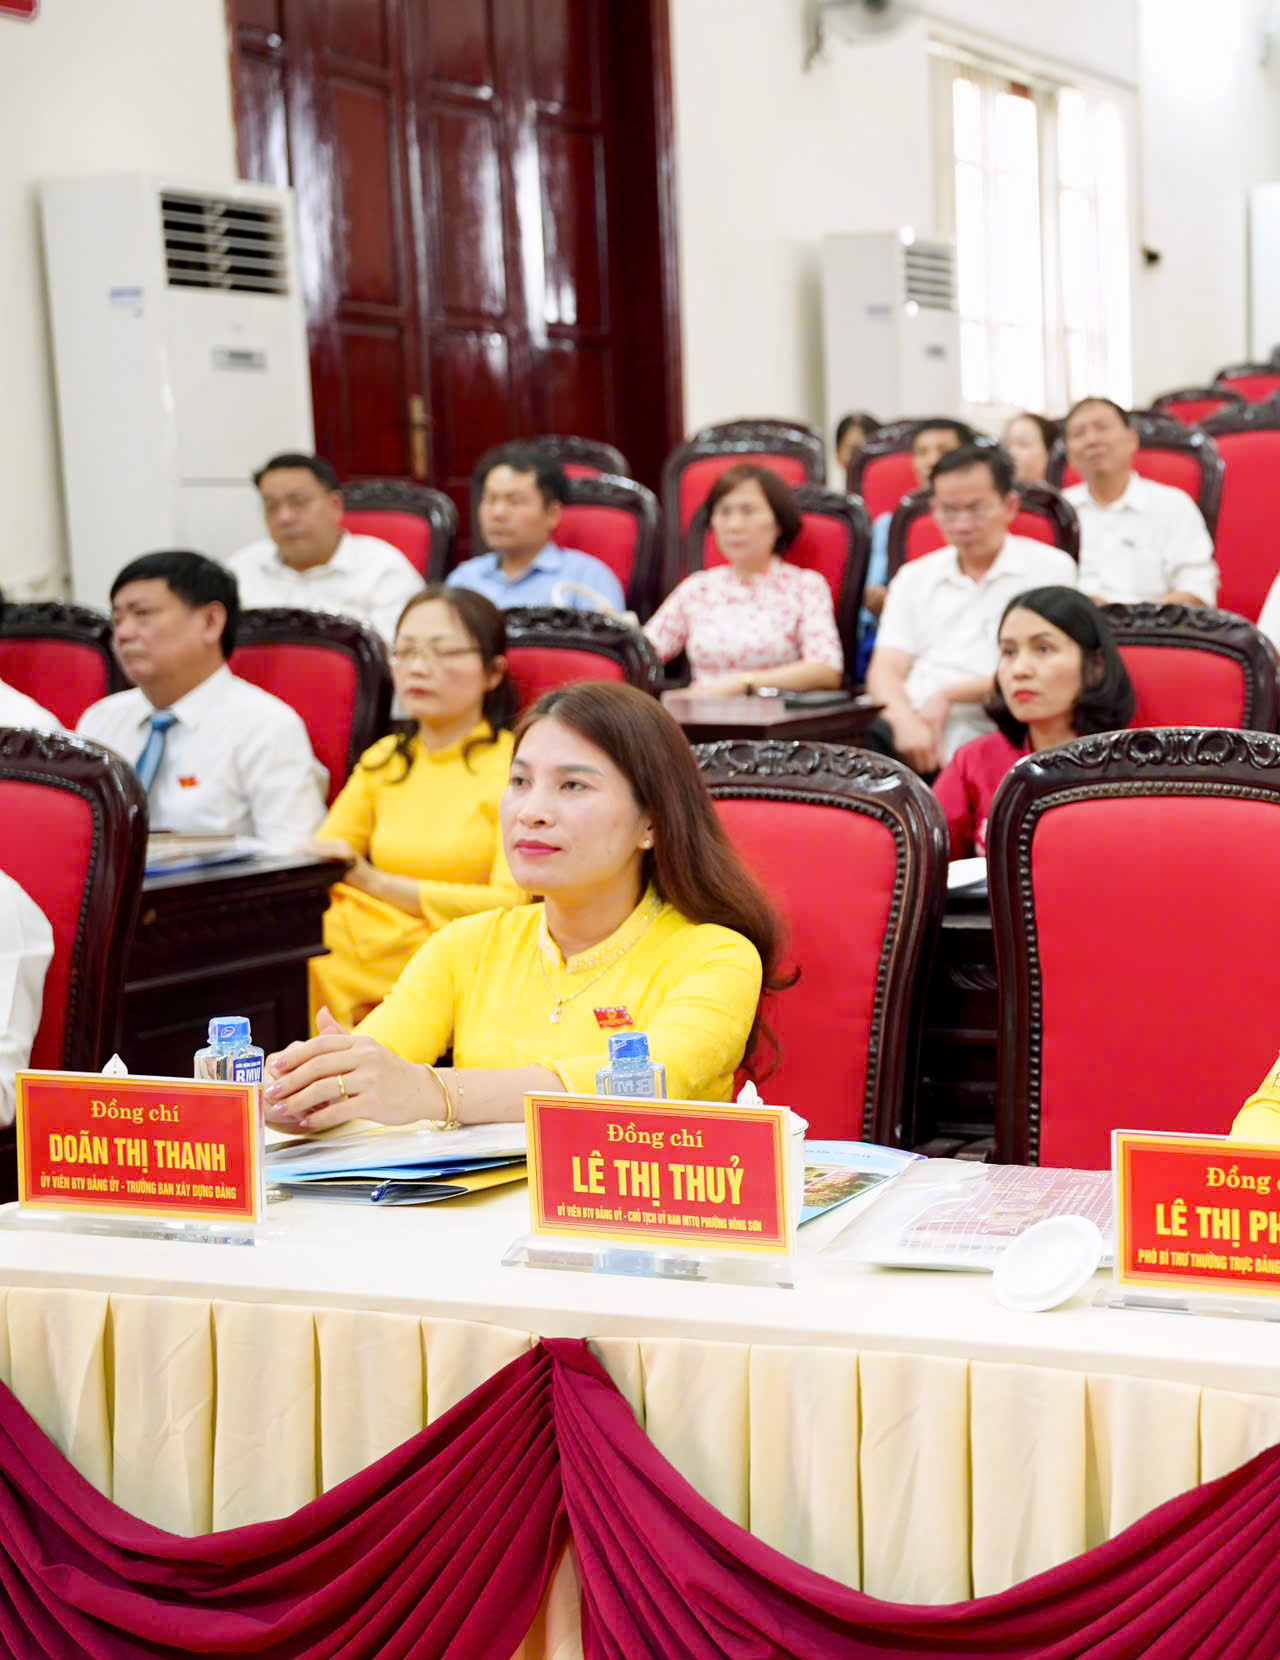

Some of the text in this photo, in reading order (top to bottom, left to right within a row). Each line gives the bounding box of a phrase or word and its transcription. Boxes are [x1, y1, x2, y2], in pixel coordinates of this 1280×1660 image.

[91, 1099, 179, 1123] Đồng chí
[607, 1123, 704, 1148] Đồng chí
[49, 1130, 226, 1173] DOÃN THỊ THANH
[52, 1175, 71, 1188] VIÊN
[71, 1177, 86, 1190] BTV
[157, 1183, 174, 1195] BAN
[572, 1150, 744, 1206] LÊ THỊ THUỶ
[1207, 1165, 1271, 1194] Đồng
[1155, 1198, 1188, 1236] LÊ
[1195, 1207, 1240, 1247] THỊ
